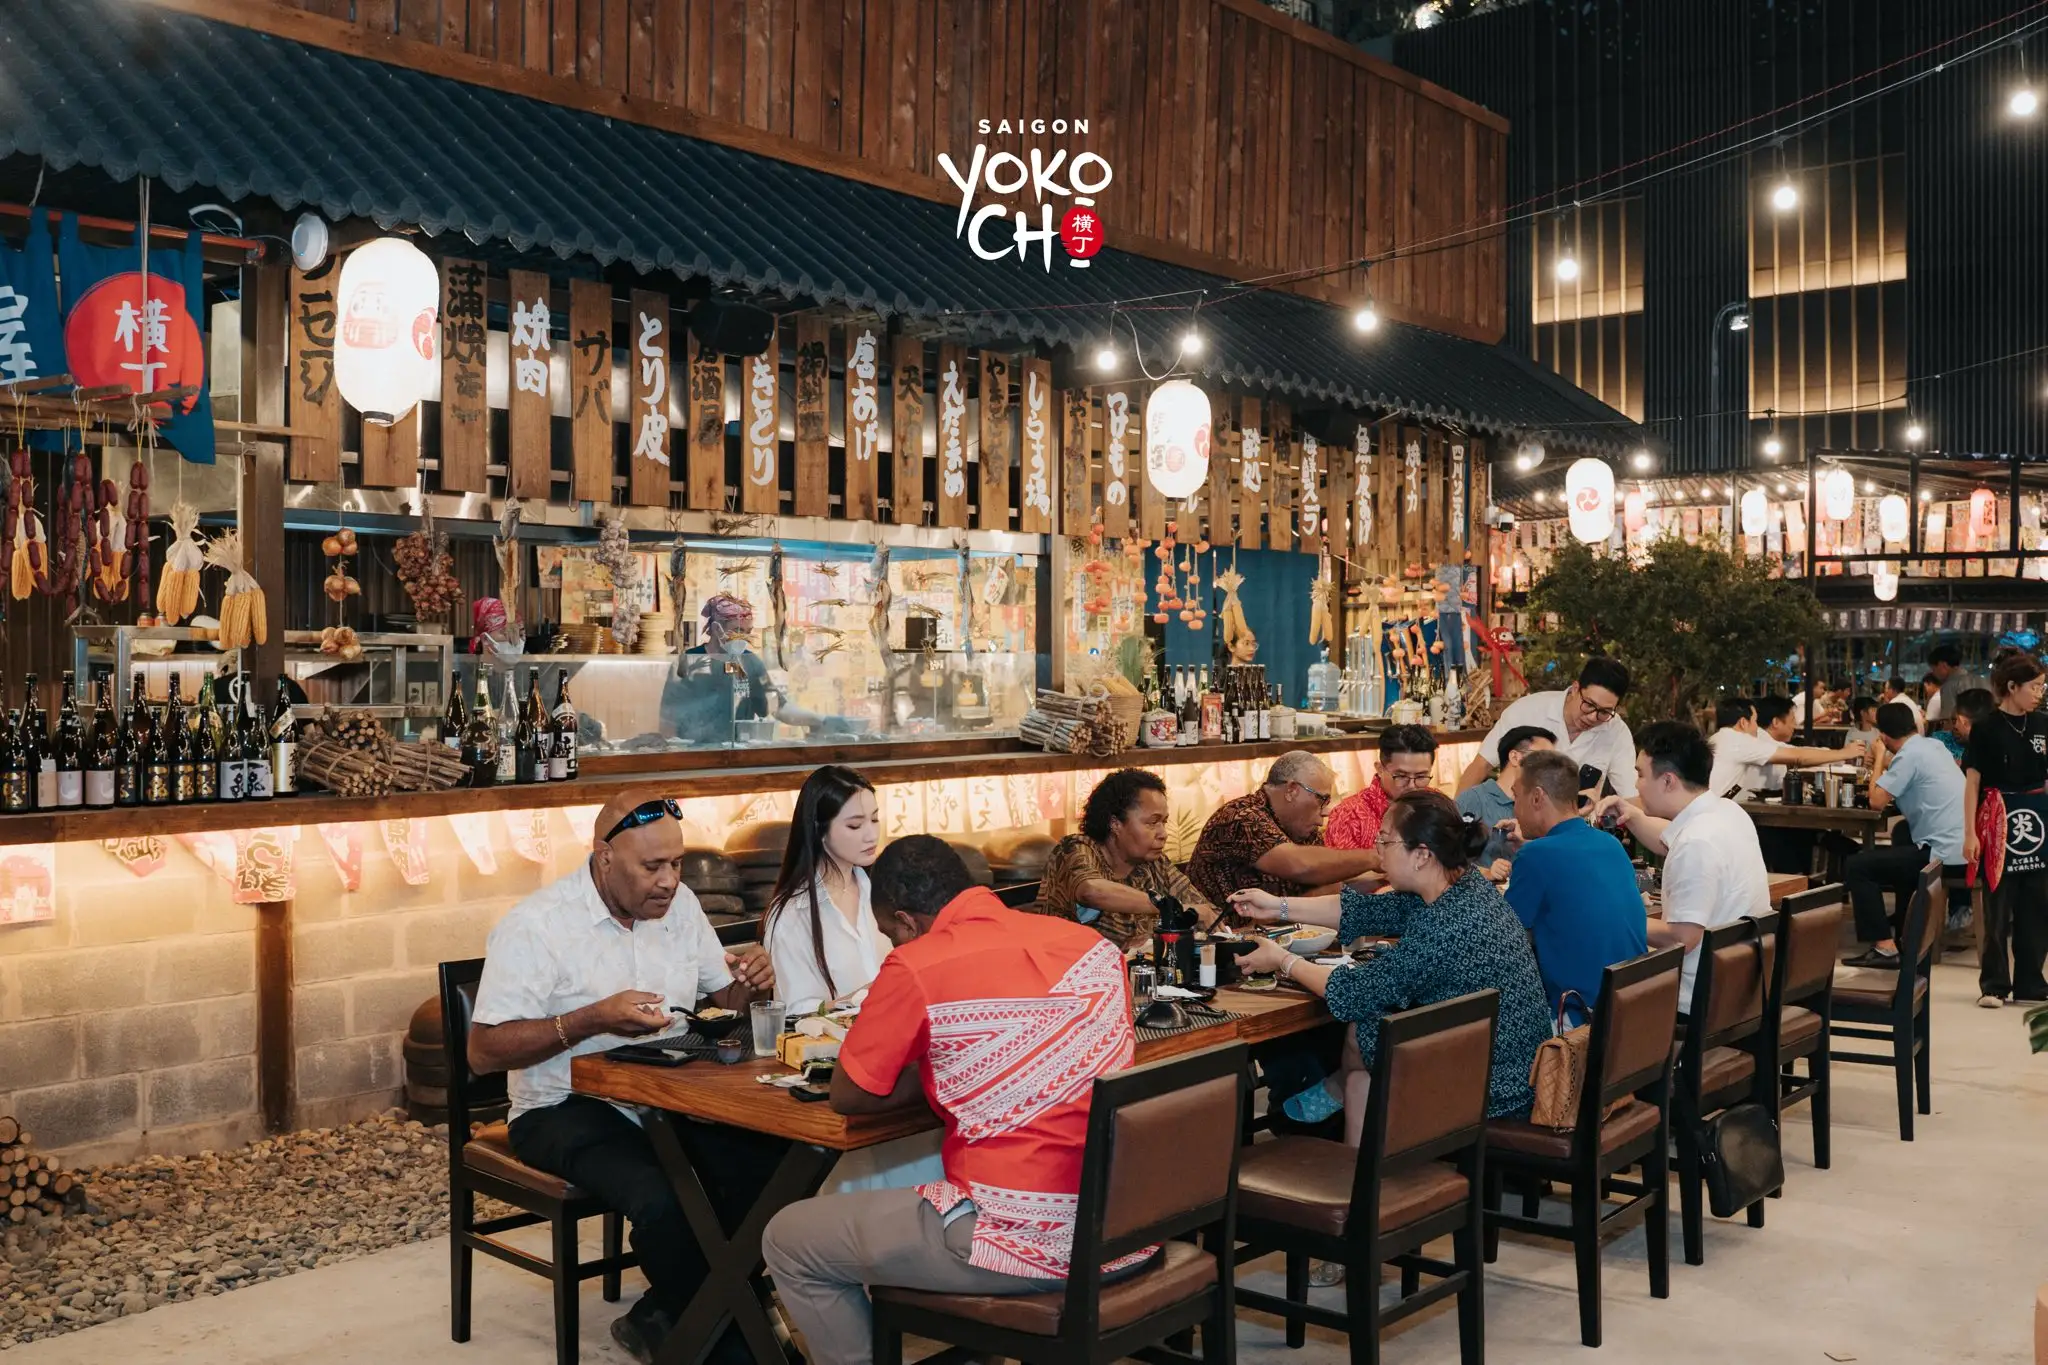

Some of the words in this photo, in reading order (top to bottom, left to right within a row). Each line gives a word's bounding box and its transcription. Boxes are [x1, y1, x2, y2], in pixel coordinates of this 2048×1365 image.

[114, 298, 172, 393] 横丁
[511, 297, 551, 397] 焼肉
[573, 330, 610, 426] サバ
[633, 311, 670, 467] とり皮
[750, 347, 775, 486] きとり
[942, 360, 966, 497] えだまめ
[2010, 813, 2041, 845] 炎
